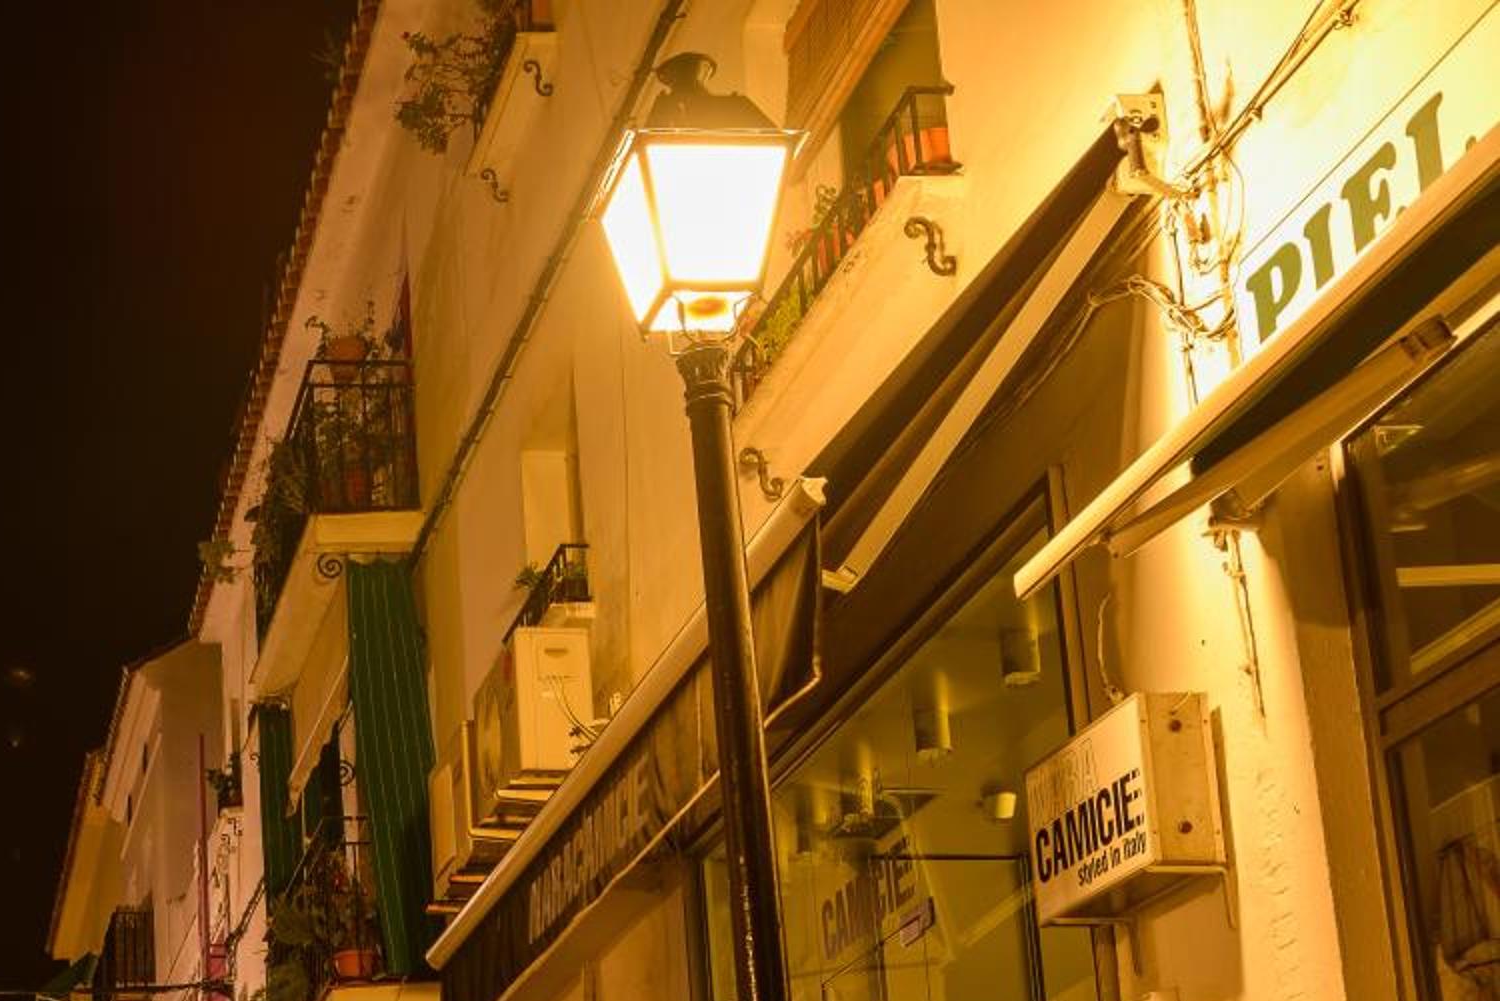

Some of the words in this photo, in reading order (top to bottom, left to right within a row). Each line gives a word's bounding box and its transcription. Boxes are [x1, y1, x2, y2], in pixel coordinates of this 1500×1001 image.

[1035, 767, 1145, 884] CAMICIE
[1077, 854, 1108, 887] styled
[1109, 845, 1121, 869] in
